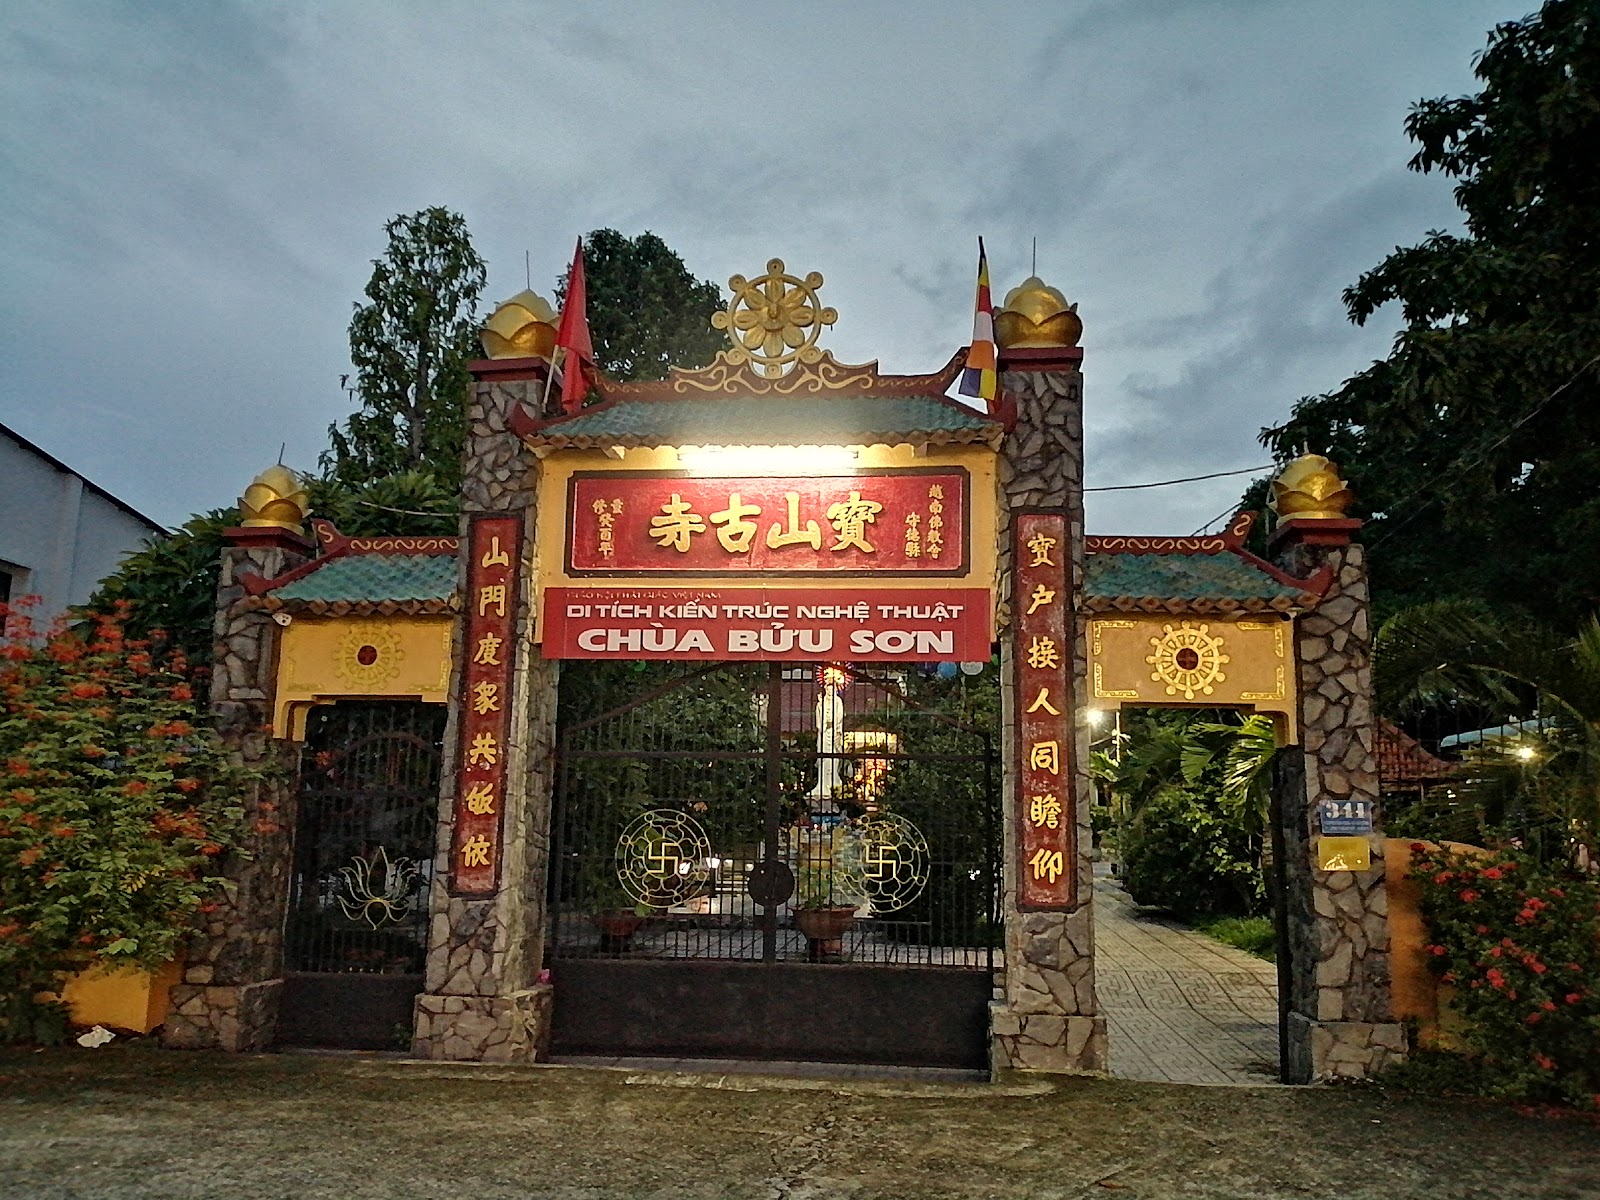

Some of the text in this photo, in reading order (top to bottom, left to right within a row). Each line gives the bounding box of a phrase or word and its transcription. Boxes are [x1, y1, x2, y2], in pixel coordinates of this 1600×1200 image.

[566, 598, 964, 623] DI TÍCH KIẾN TRÚC NGHỆ THUẬT
[577, 622, 954, 654] CHÙA BỬU SƠN
